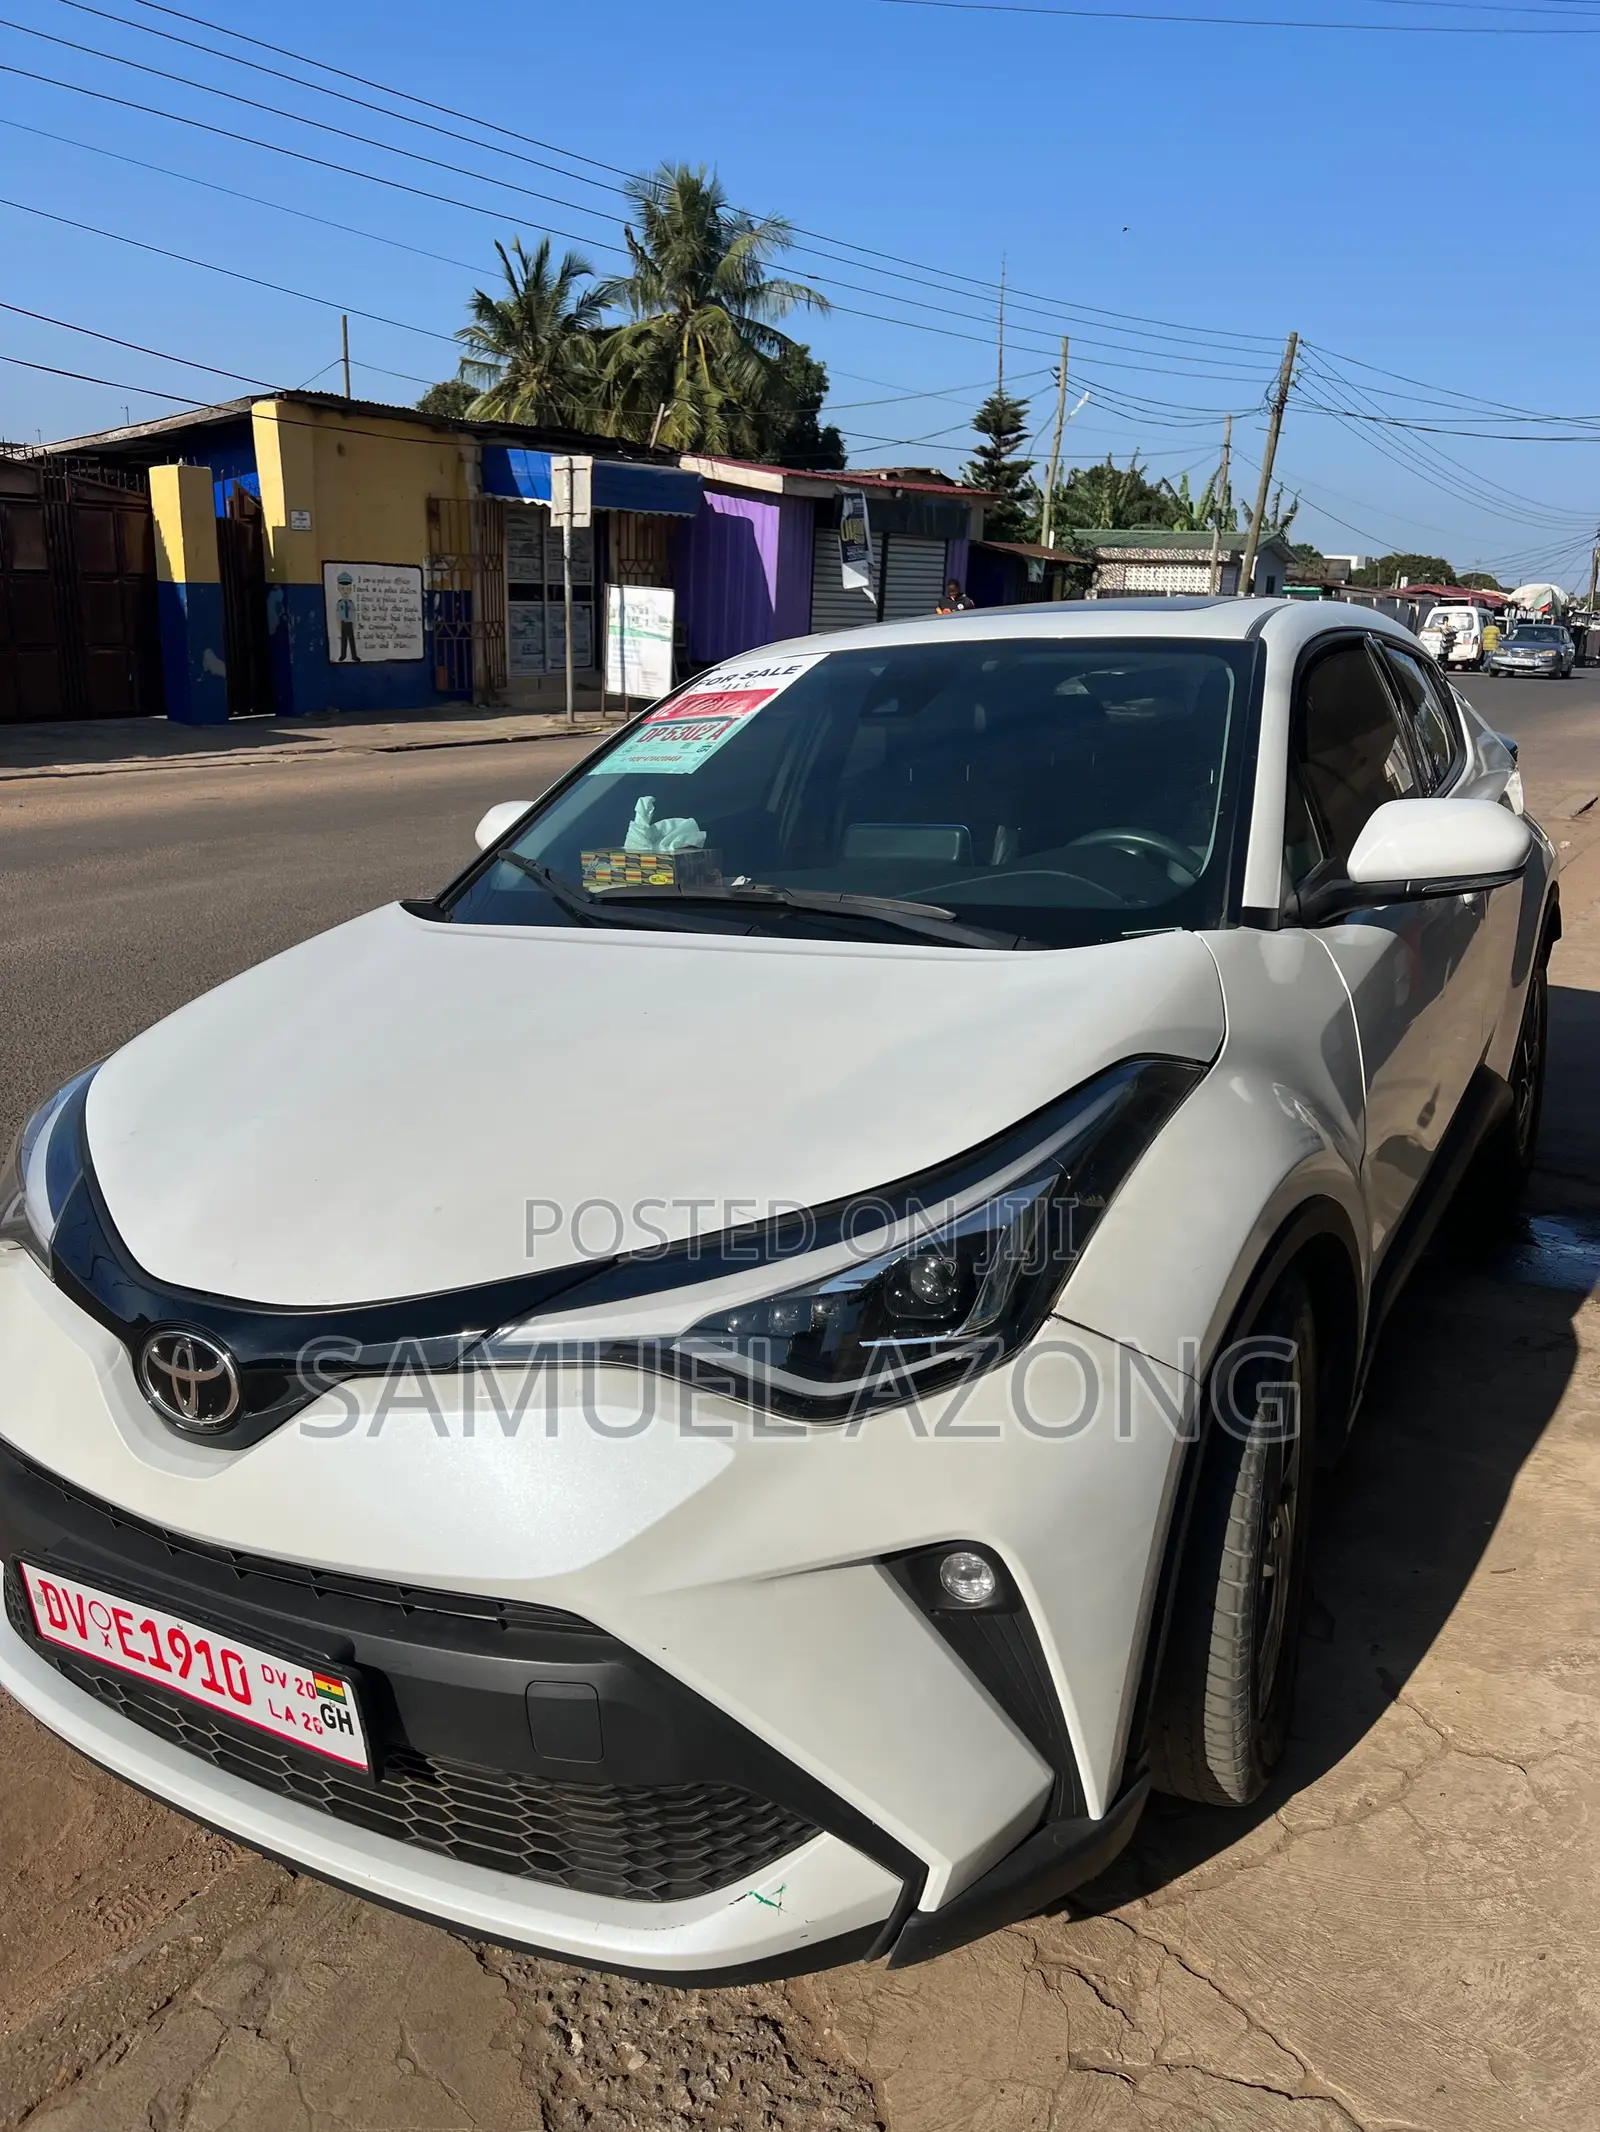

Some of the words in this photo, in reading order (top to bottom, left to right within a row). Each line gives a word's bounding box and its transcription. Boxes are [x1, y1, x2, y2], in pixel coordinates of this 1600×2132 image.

[700, 674, 738, 686] FOR
[739, 665, 803, 680] SALE
[261, 1663, 287, 1690] DV
[294, 1677, 317, 1700] 20
[268, 1698, 297, 1725] LA
[320, 1703, 354, 1736] GH
